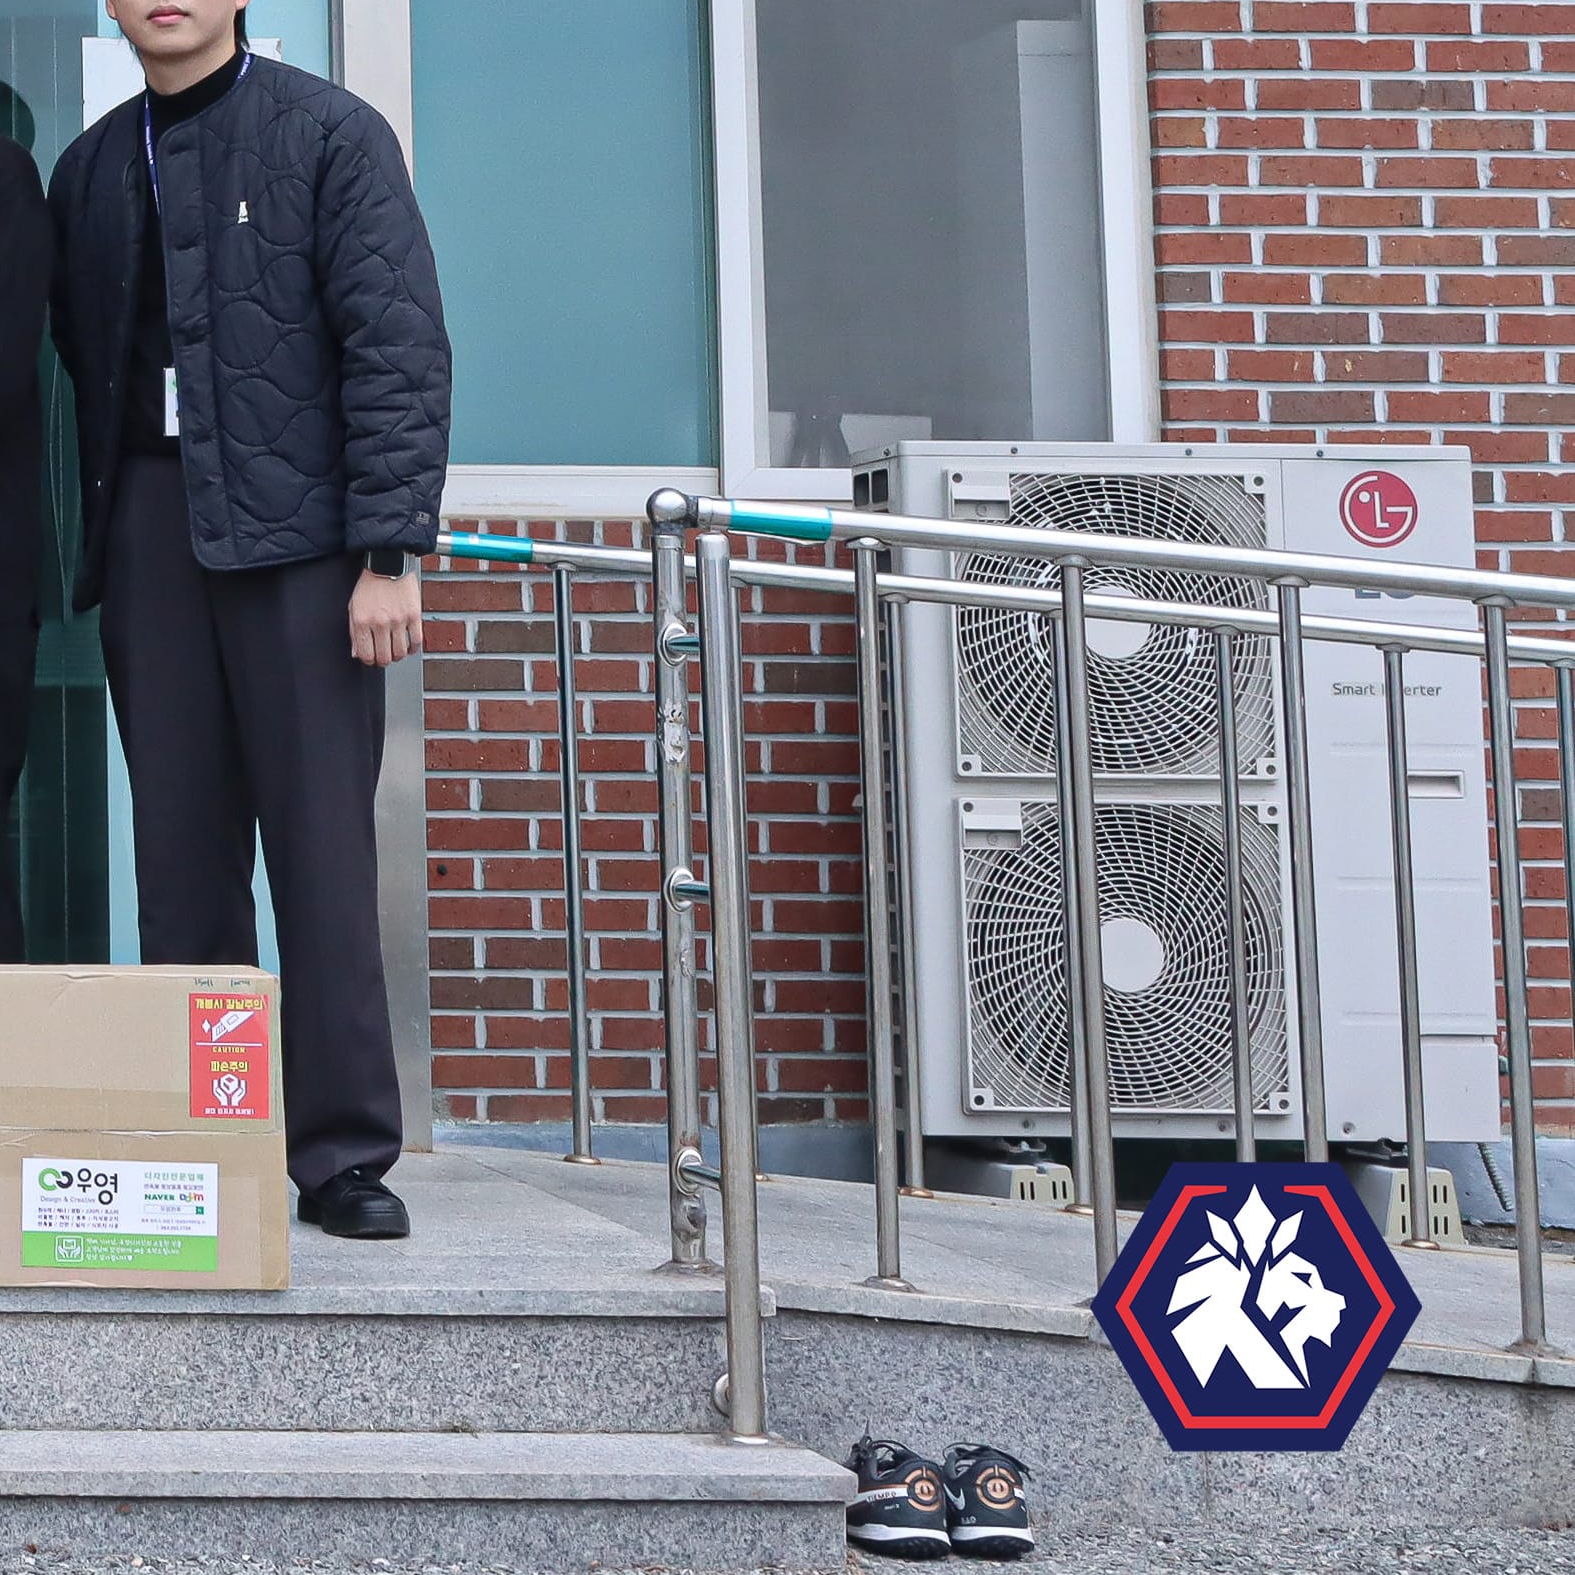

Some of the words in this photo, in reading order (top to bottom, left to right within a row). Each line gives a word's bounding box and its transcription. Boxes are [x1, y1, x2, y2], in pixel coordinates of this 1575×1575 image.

[1332, 683, 1375, 696] Smart
[1381, 683, 1442, 696] Ierter
[77, 1168, 118, 1205] 우영
